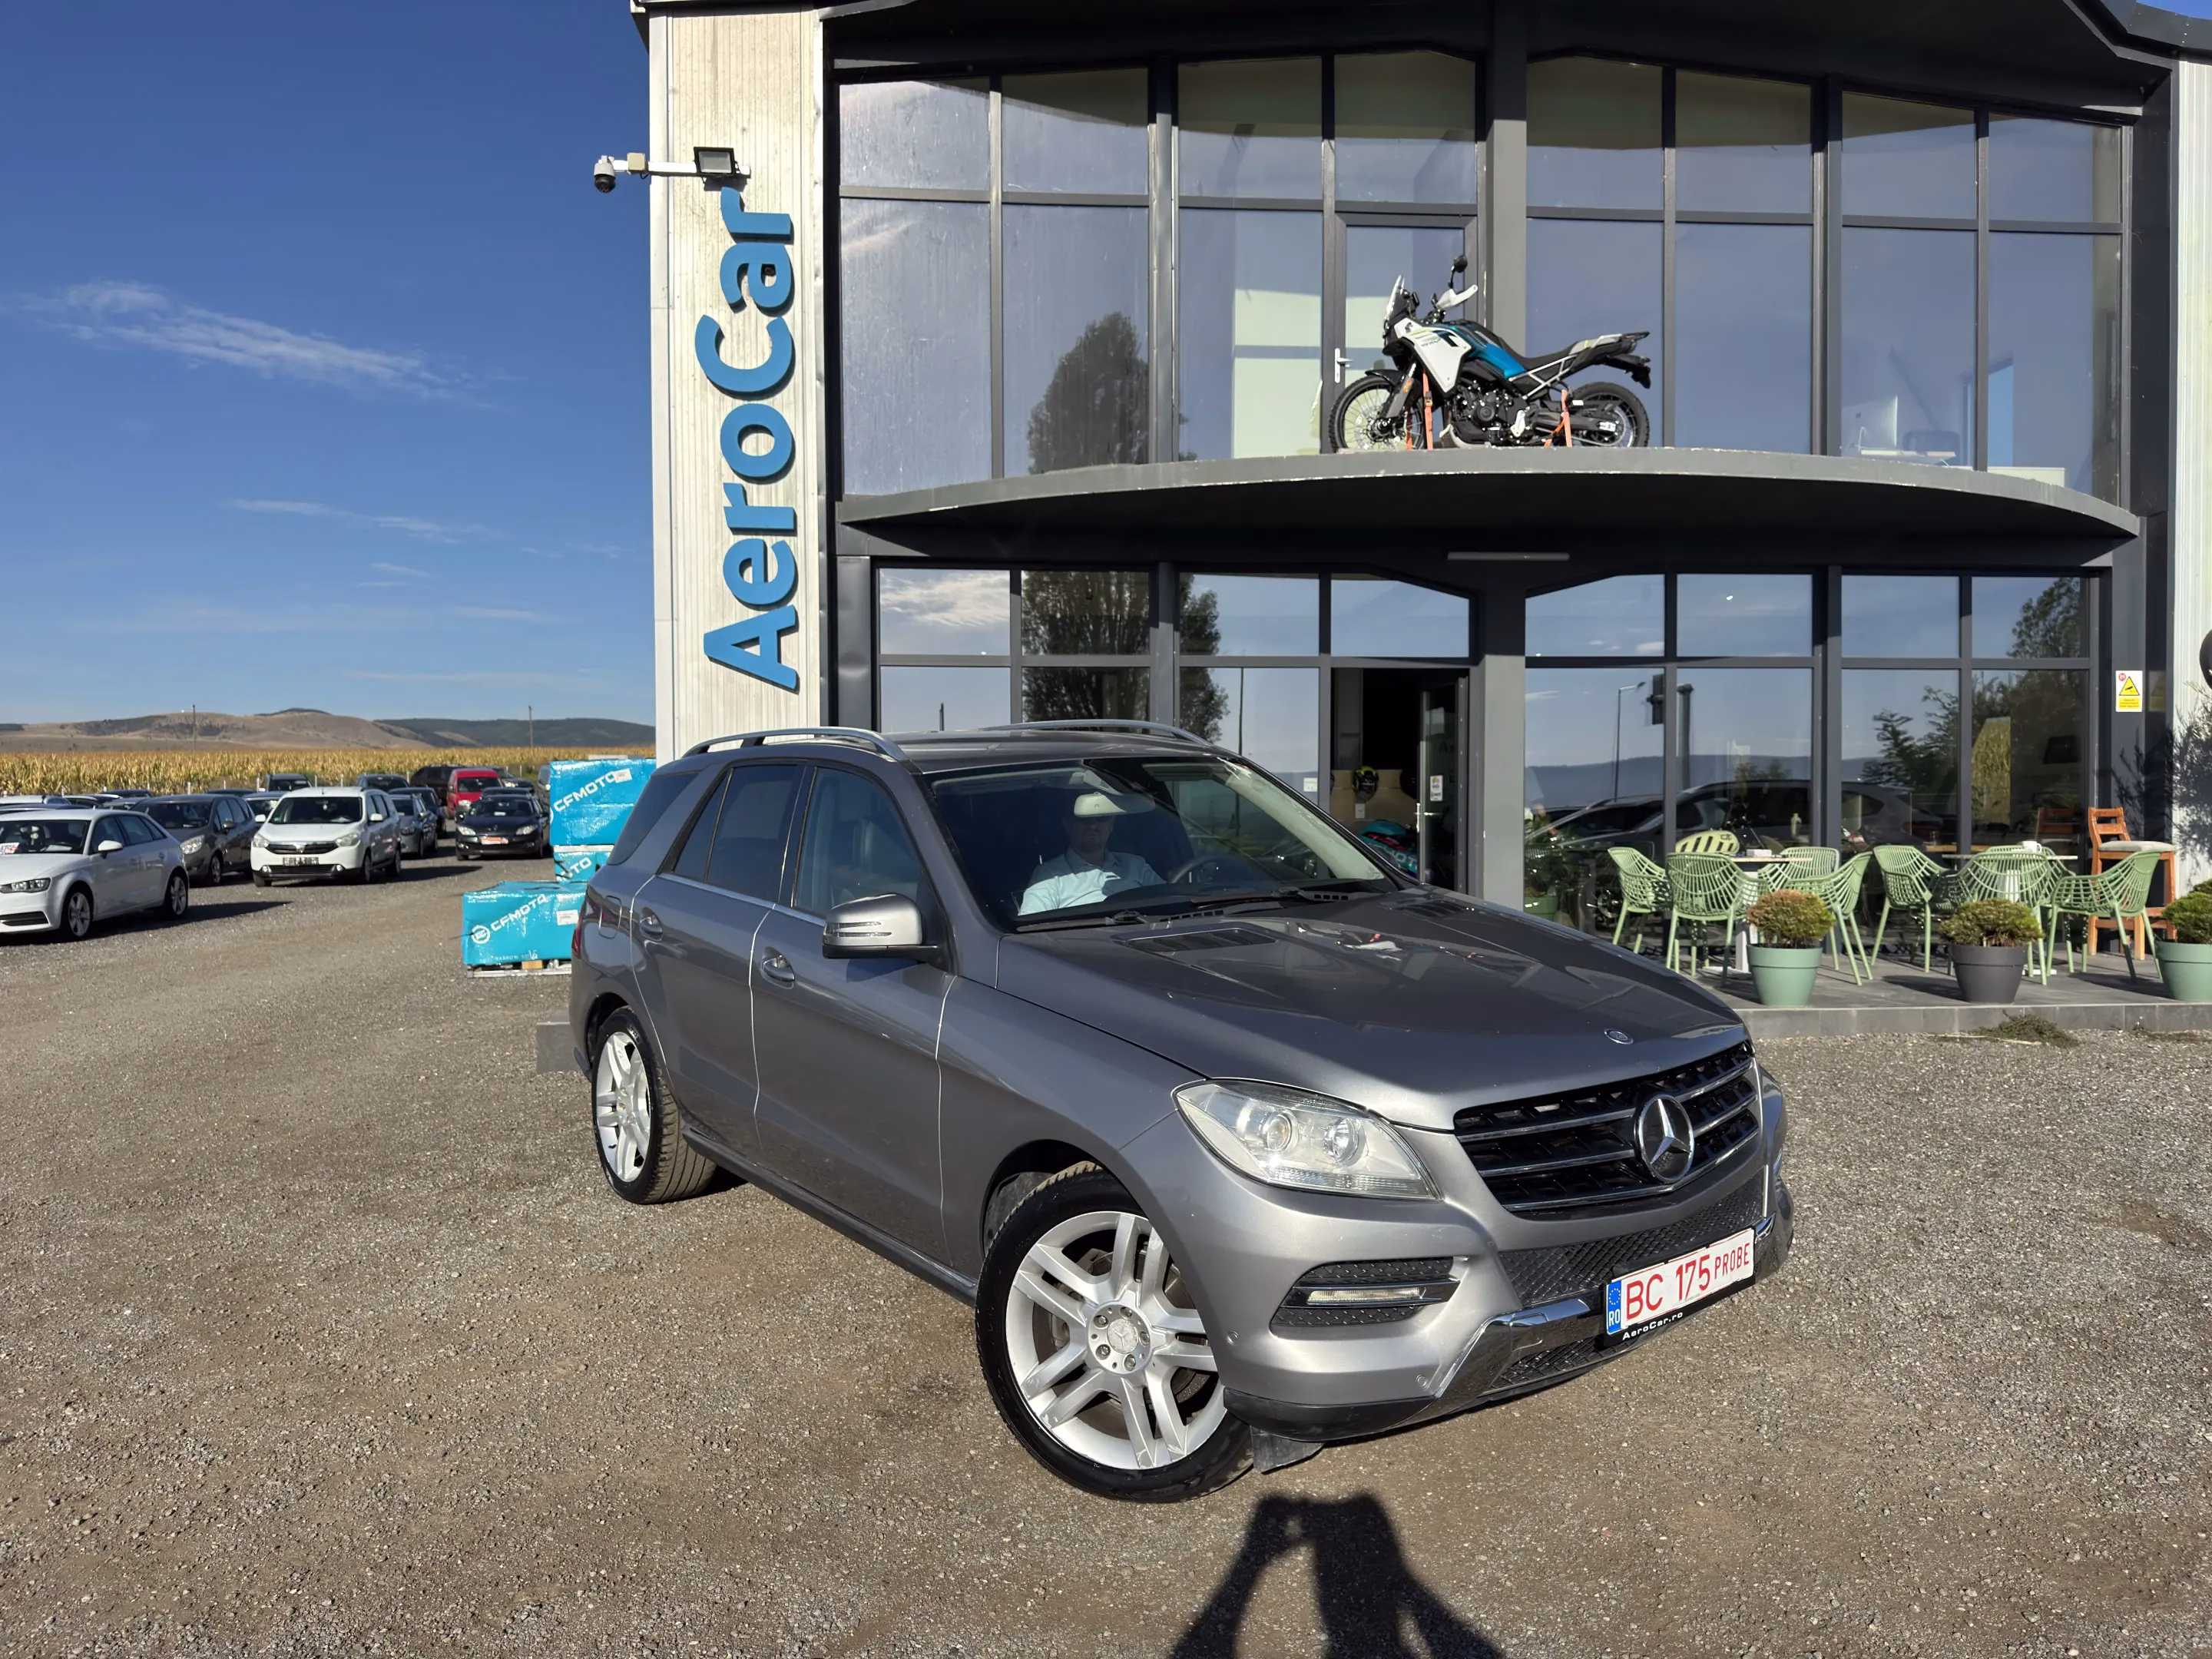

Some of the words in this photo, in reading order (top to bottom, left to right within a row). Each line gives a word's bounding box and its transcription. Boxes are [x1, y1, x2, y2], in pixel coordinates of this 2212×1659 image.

[694, 187, 797, 690] AeroCar
[553, 771, 615, 812] CFMOTO
[490, 893, 548, 932] CFMOTO
[1626, 1273, 1663, 1320] BC
[1675, 1254, 1710, 1300] 175
[1714, 1243, 1750, 1280] PROBE
[1608, 1308, 1621, 1327] RO
[1622, 1312, 1683, 1341] AeroCar.ro
